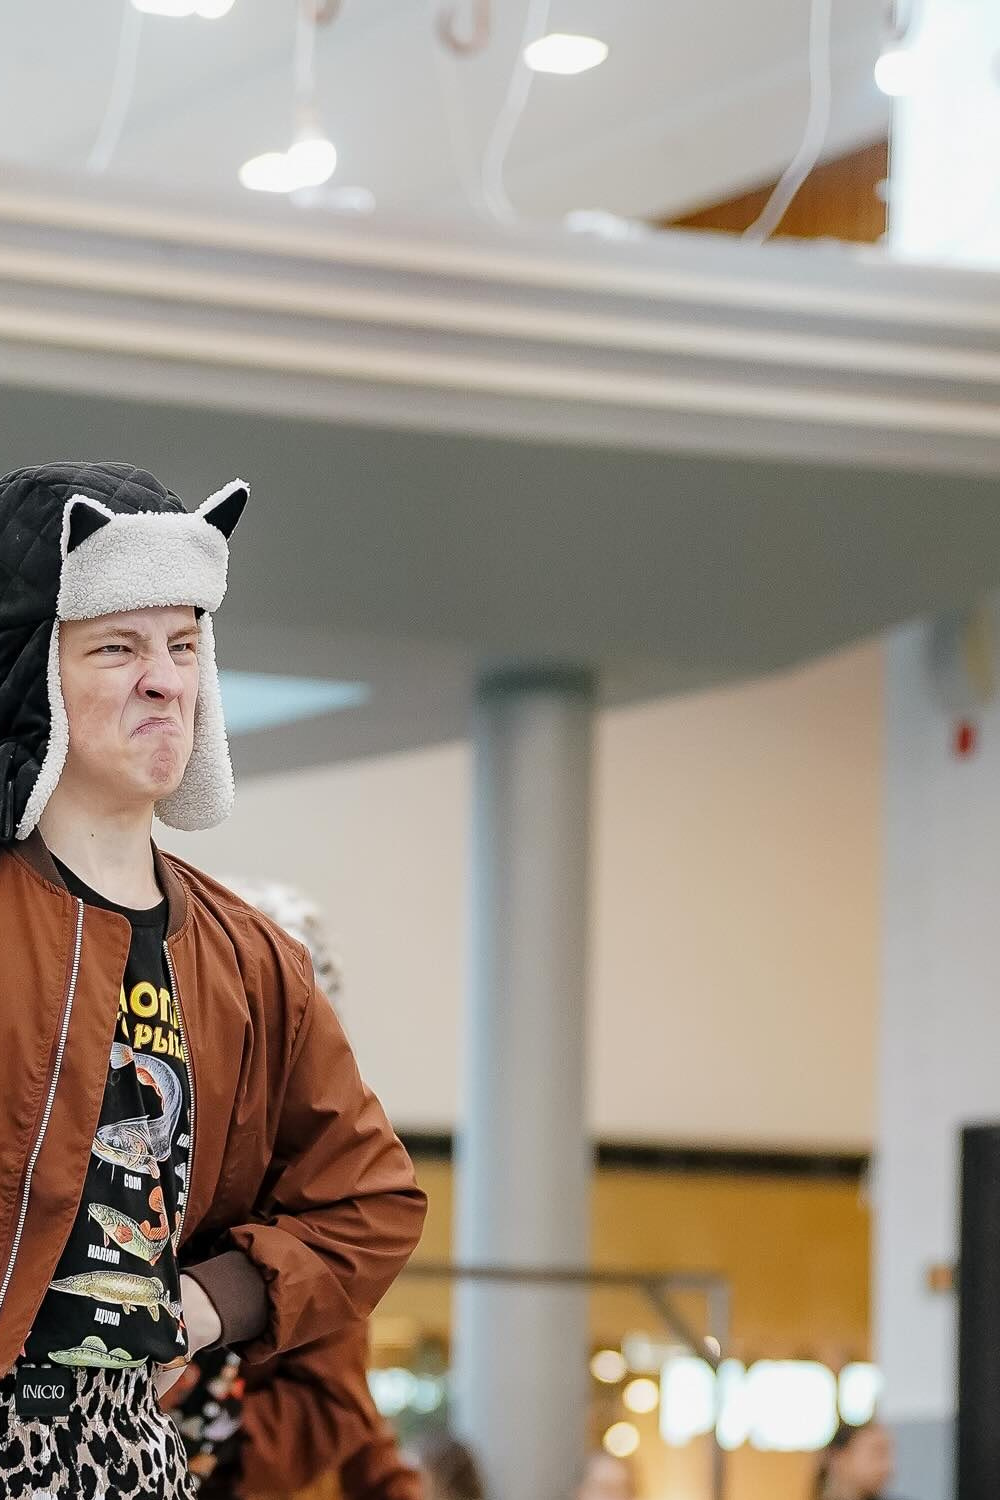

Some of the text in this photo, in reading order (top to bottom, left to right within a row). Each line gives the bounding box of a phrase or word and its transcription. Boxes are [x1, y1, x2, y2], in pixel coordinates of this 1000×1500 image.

[124, 1173, 142, 1191] СОМ
[87, 1243, 121, 1265] НАЛИМ
[94, 1307, 121, 1327] ЩУКА
[22, 1384, 66, 1400] INICIO
